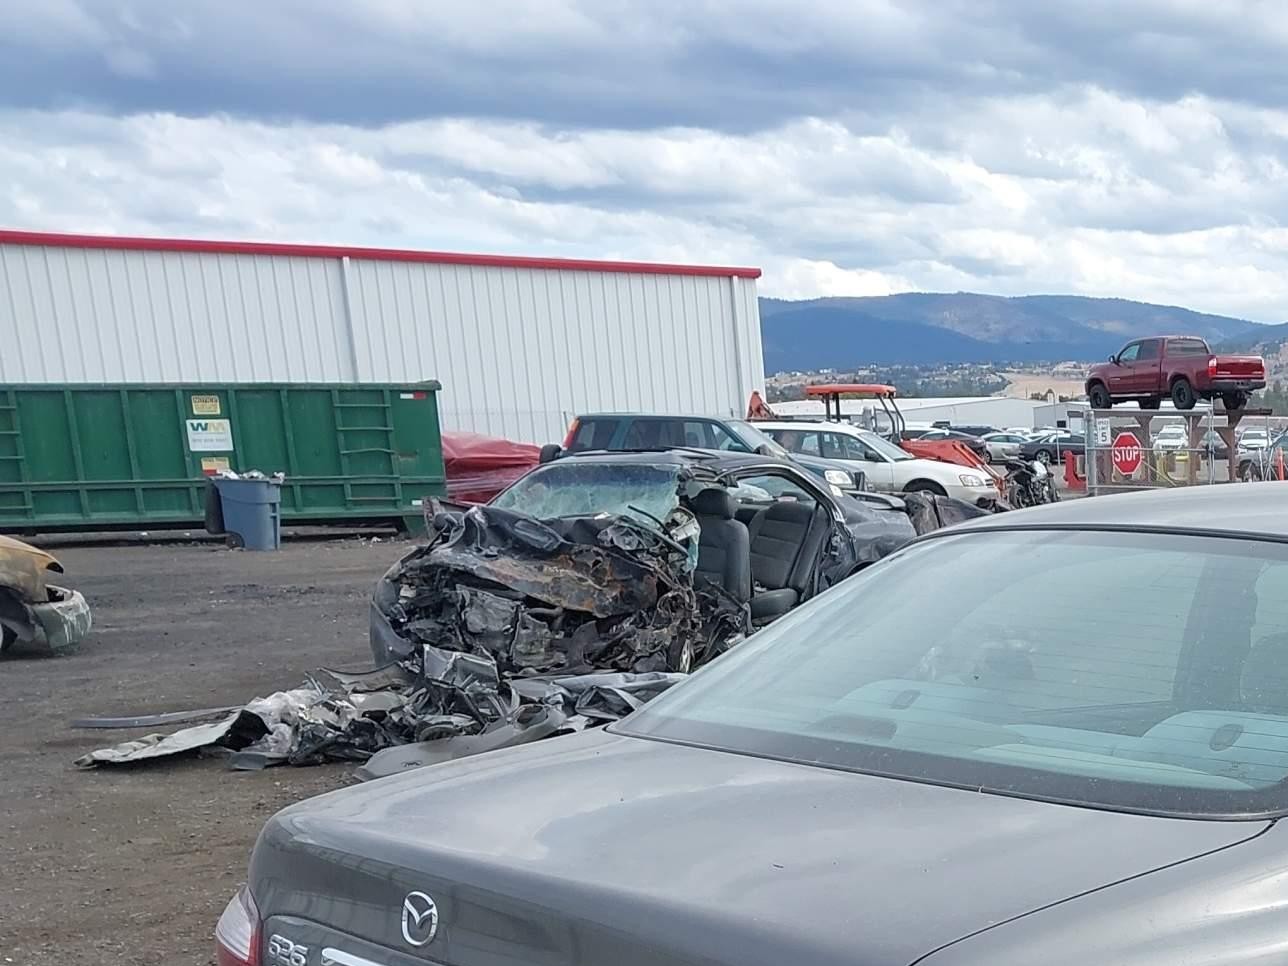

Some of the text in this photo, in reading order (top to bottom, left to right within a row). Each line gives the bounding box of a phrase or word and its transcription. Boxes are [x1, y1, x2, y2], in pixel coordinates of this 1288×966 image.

[190, 422, 226, 432] WM
[1101, 432, 1107, 442] 5
[1114, 446, 1139, 462] STOP
